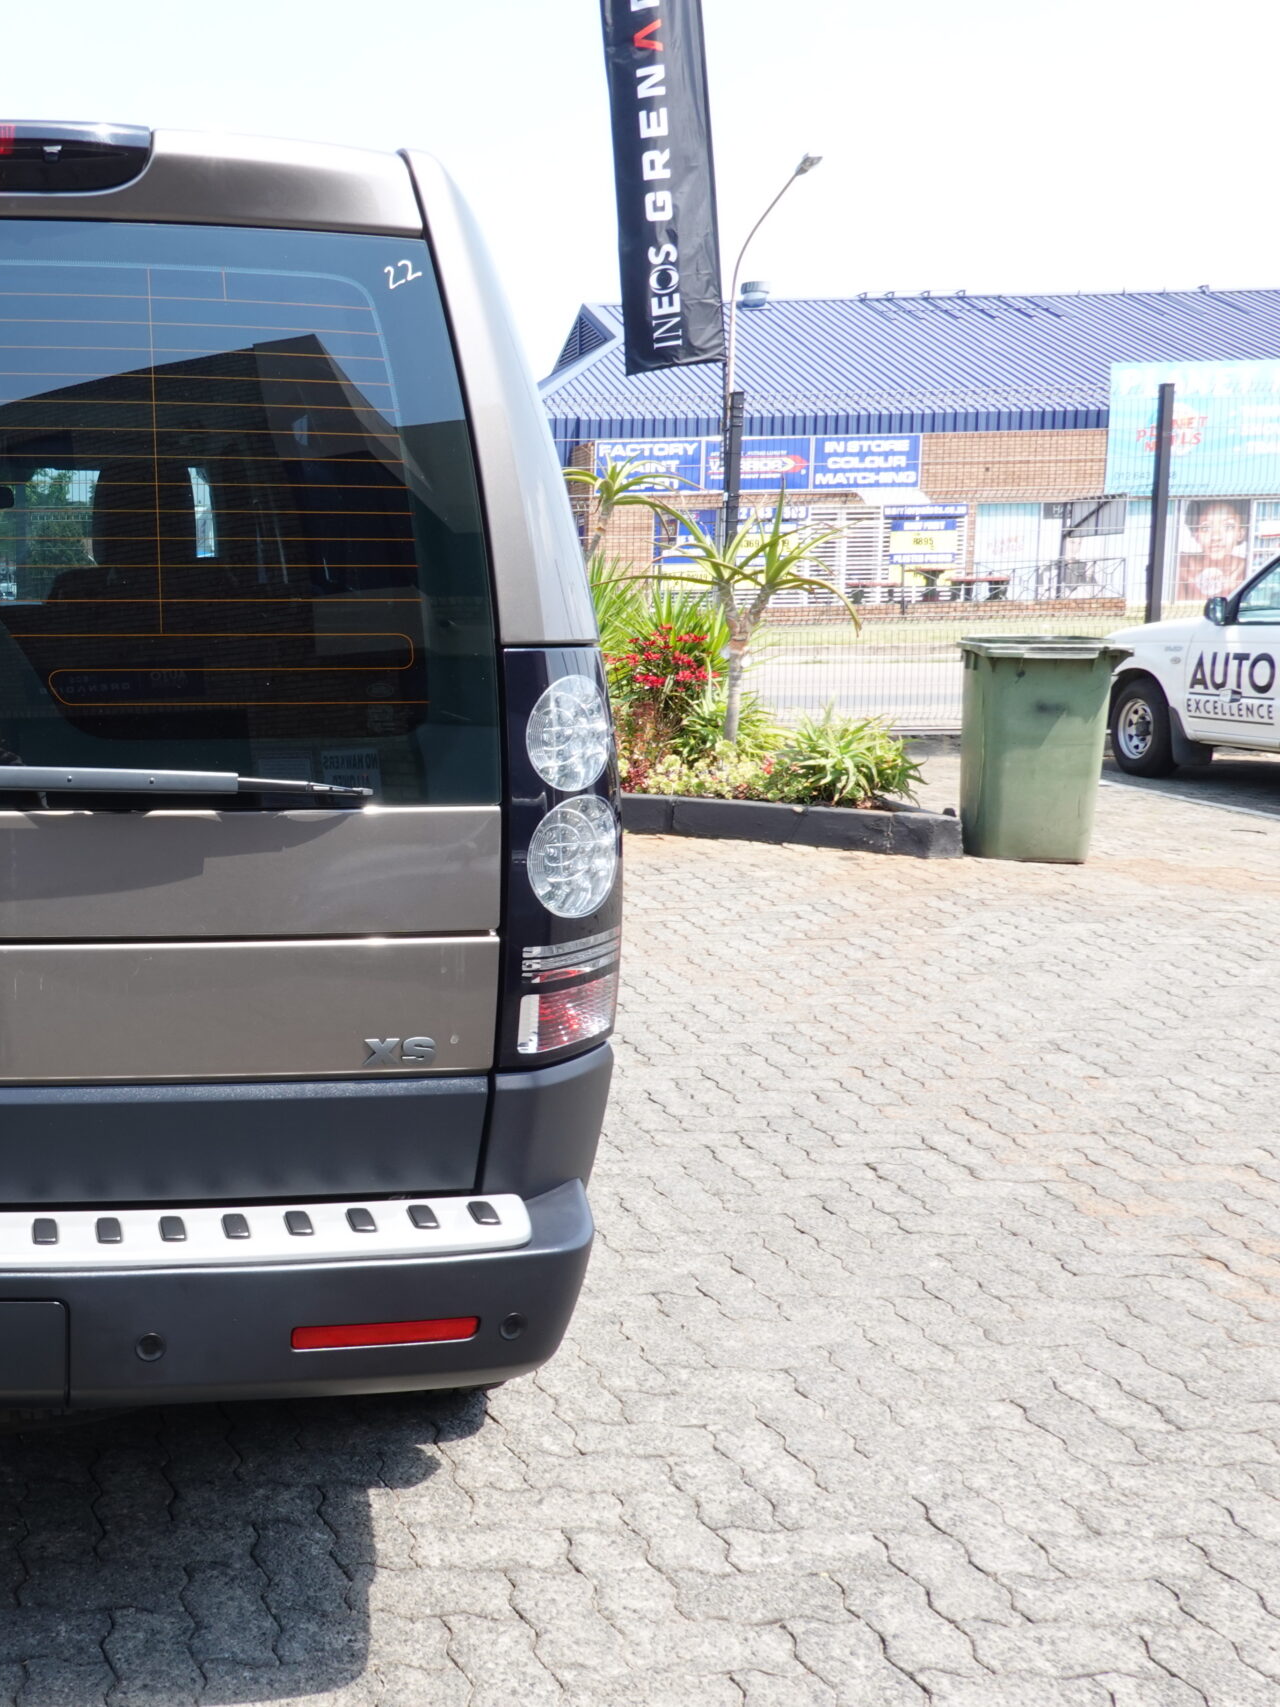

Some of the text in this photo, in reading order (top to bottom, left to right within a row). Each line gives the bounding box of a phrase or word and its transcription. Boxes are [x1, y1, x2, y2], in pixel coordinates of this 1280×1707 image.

[384, 259, 422, 290] 22
[648, 243, 684, 351] INEOS
[1136, 416, 1209, 442] PLNET
[598, 442, 699, 457] FACTORY
[824, 439, 910, 453] IN STORE
[827, 456, 906, 468] COLOUR
[815, 472, 917, 485] MATCHING
[1189, 650, 1276, 694] AUTO
[1186, 698, 1274, 720] EXCELLENCE
[363, 1036, 437, 1065] XS
